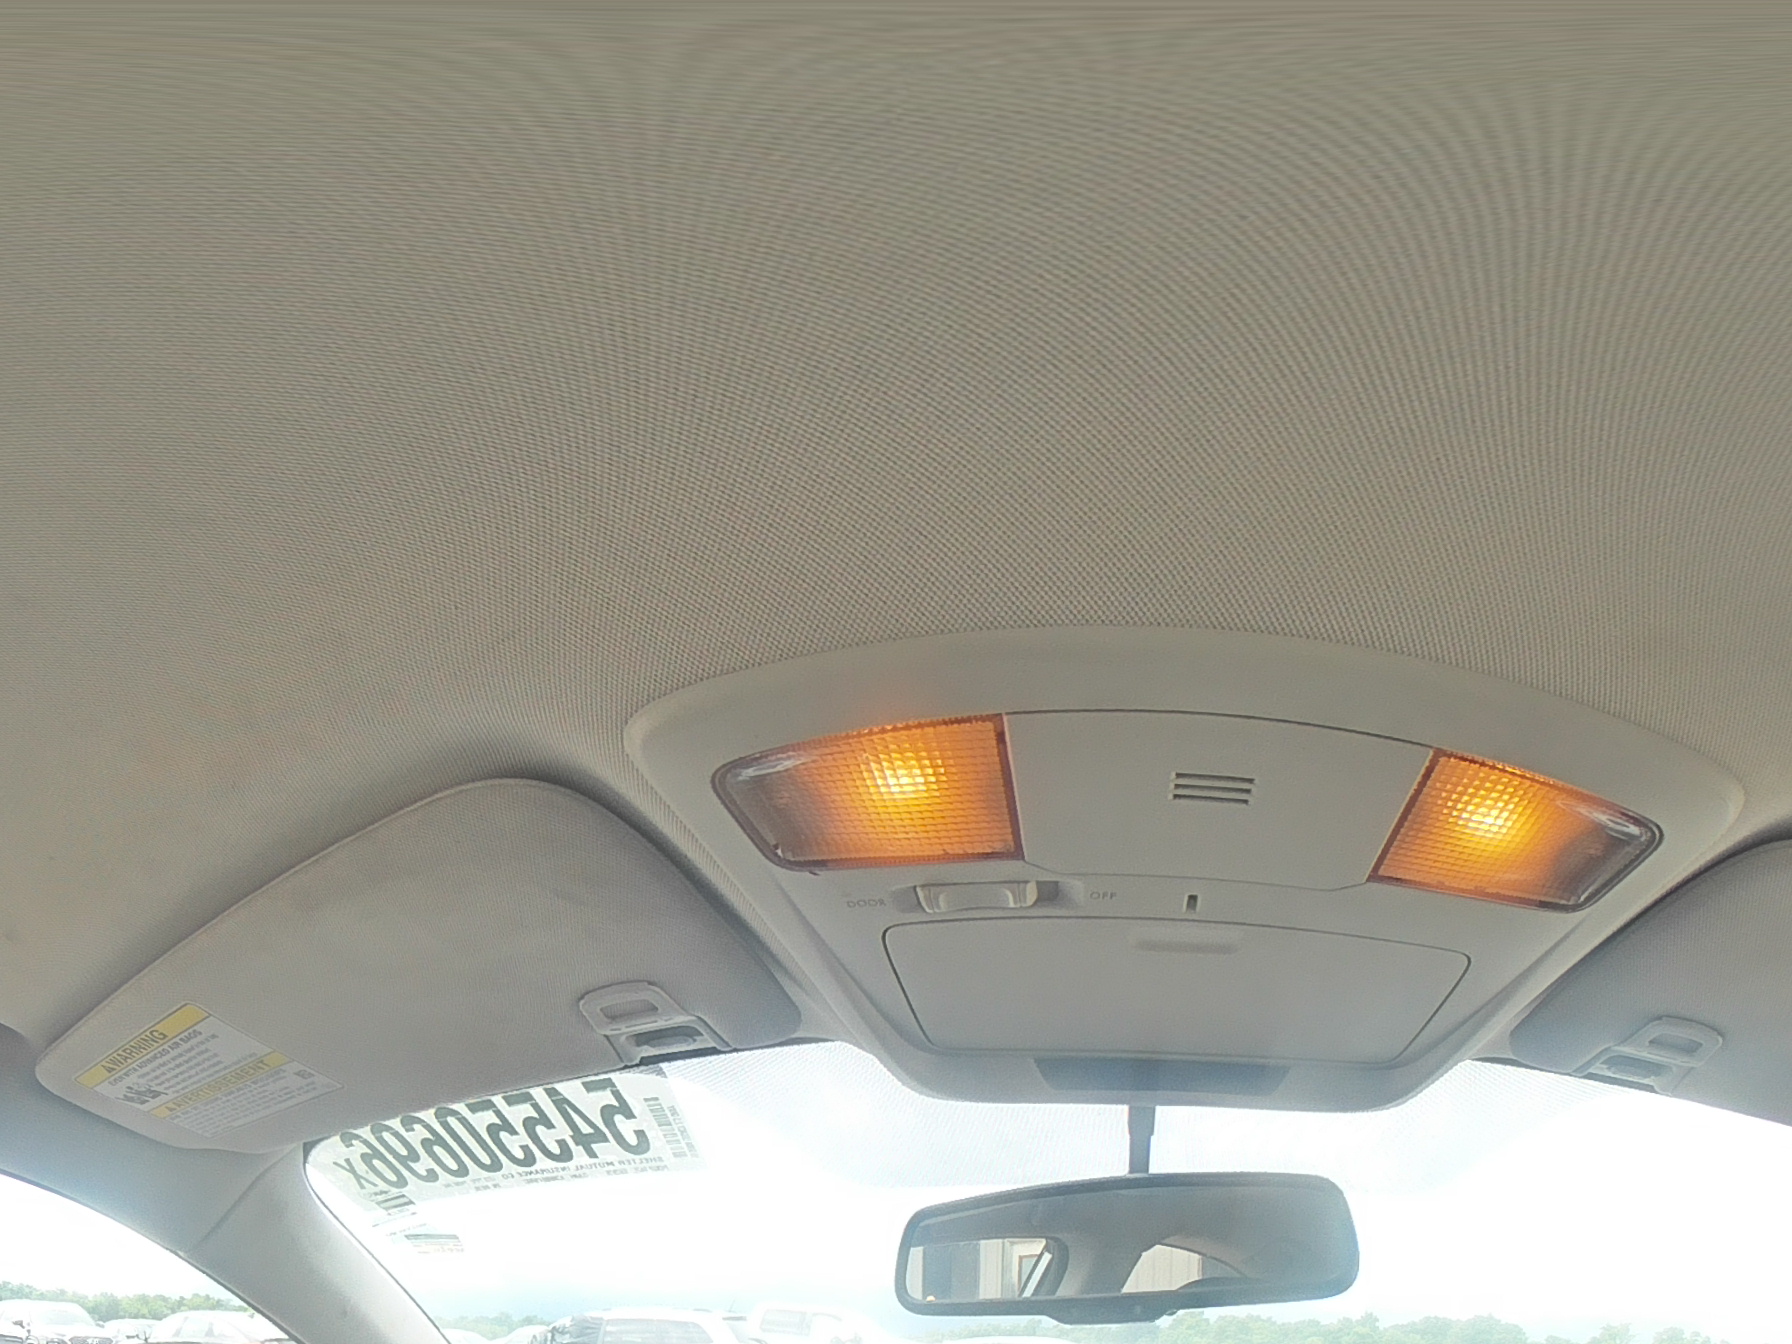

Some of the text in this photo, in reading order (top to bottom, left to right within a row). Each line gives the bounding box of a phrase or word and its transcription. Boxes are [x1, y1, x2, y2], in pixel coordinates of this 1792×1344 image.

[846, 891, 1118, 909] DOOR OFF
[104, 1029, 169, 1068] WARNING
[172, 1059, 273, 1107] AVERTISSEMENT
